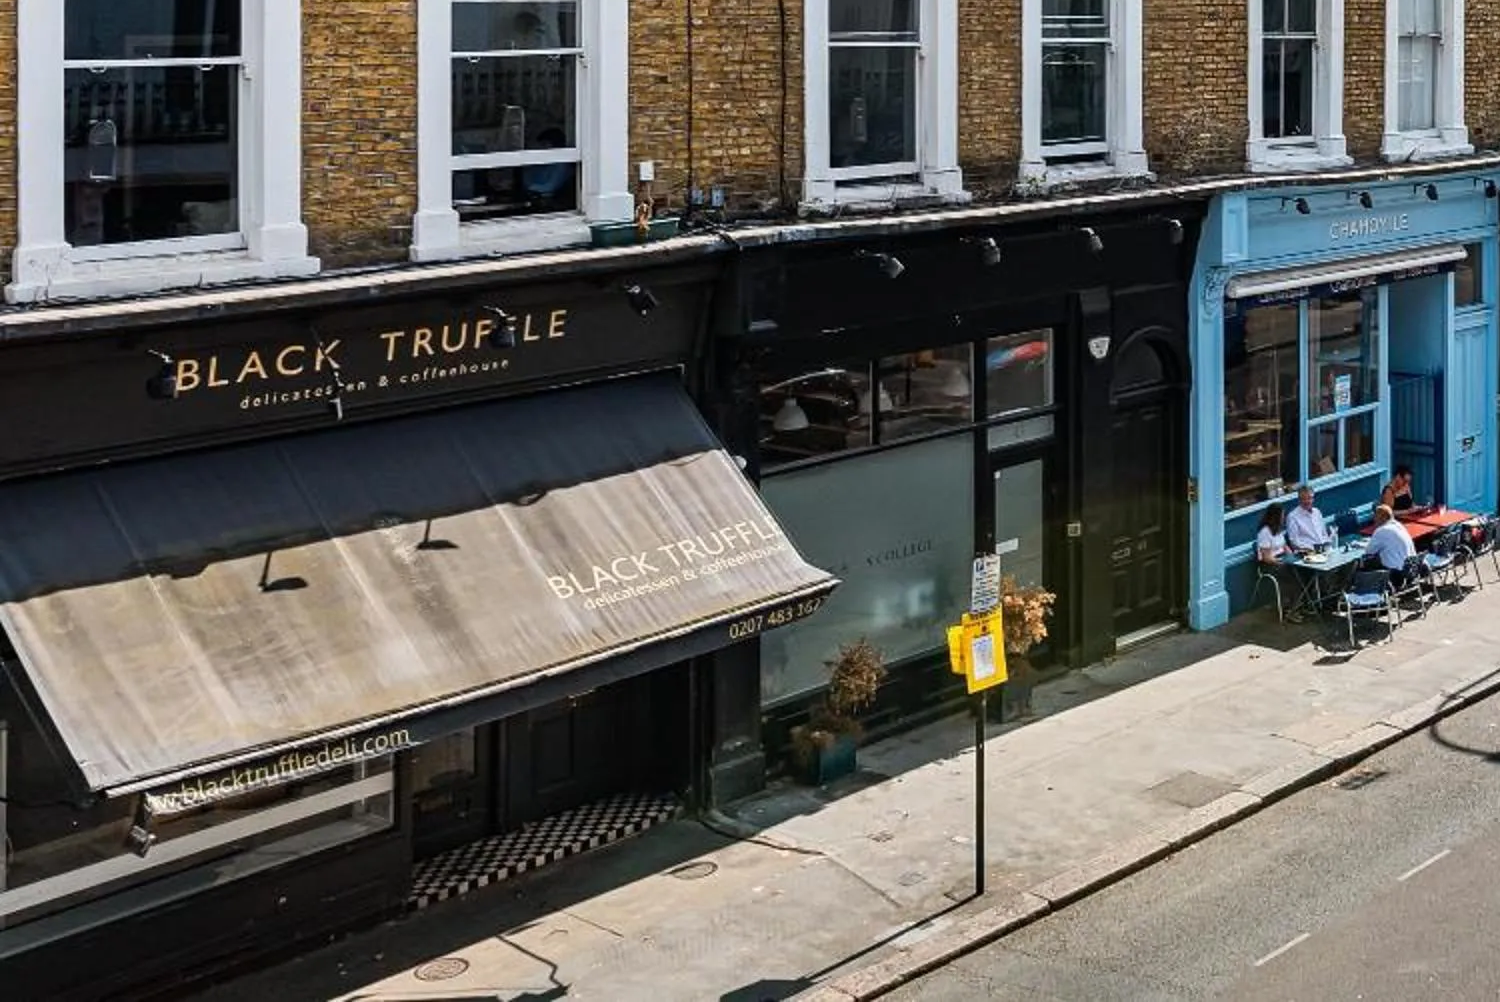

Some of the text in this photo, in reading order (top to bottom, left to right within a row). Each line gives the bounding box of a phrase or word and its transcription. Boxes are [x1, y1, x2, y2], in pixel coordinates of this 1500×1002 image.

[175, 309, 568, 391] BLACK TRUFLE
[240, 358, 510, 410] delicatesen & coffeehouse
[548, 551, 660, 600] BLACK
[583, 574, 681, 612] delicatessen
[681, 568, 699, 582] &
[728, 615, 764, 640] 0207
[767, 607, 794, 626] 483
